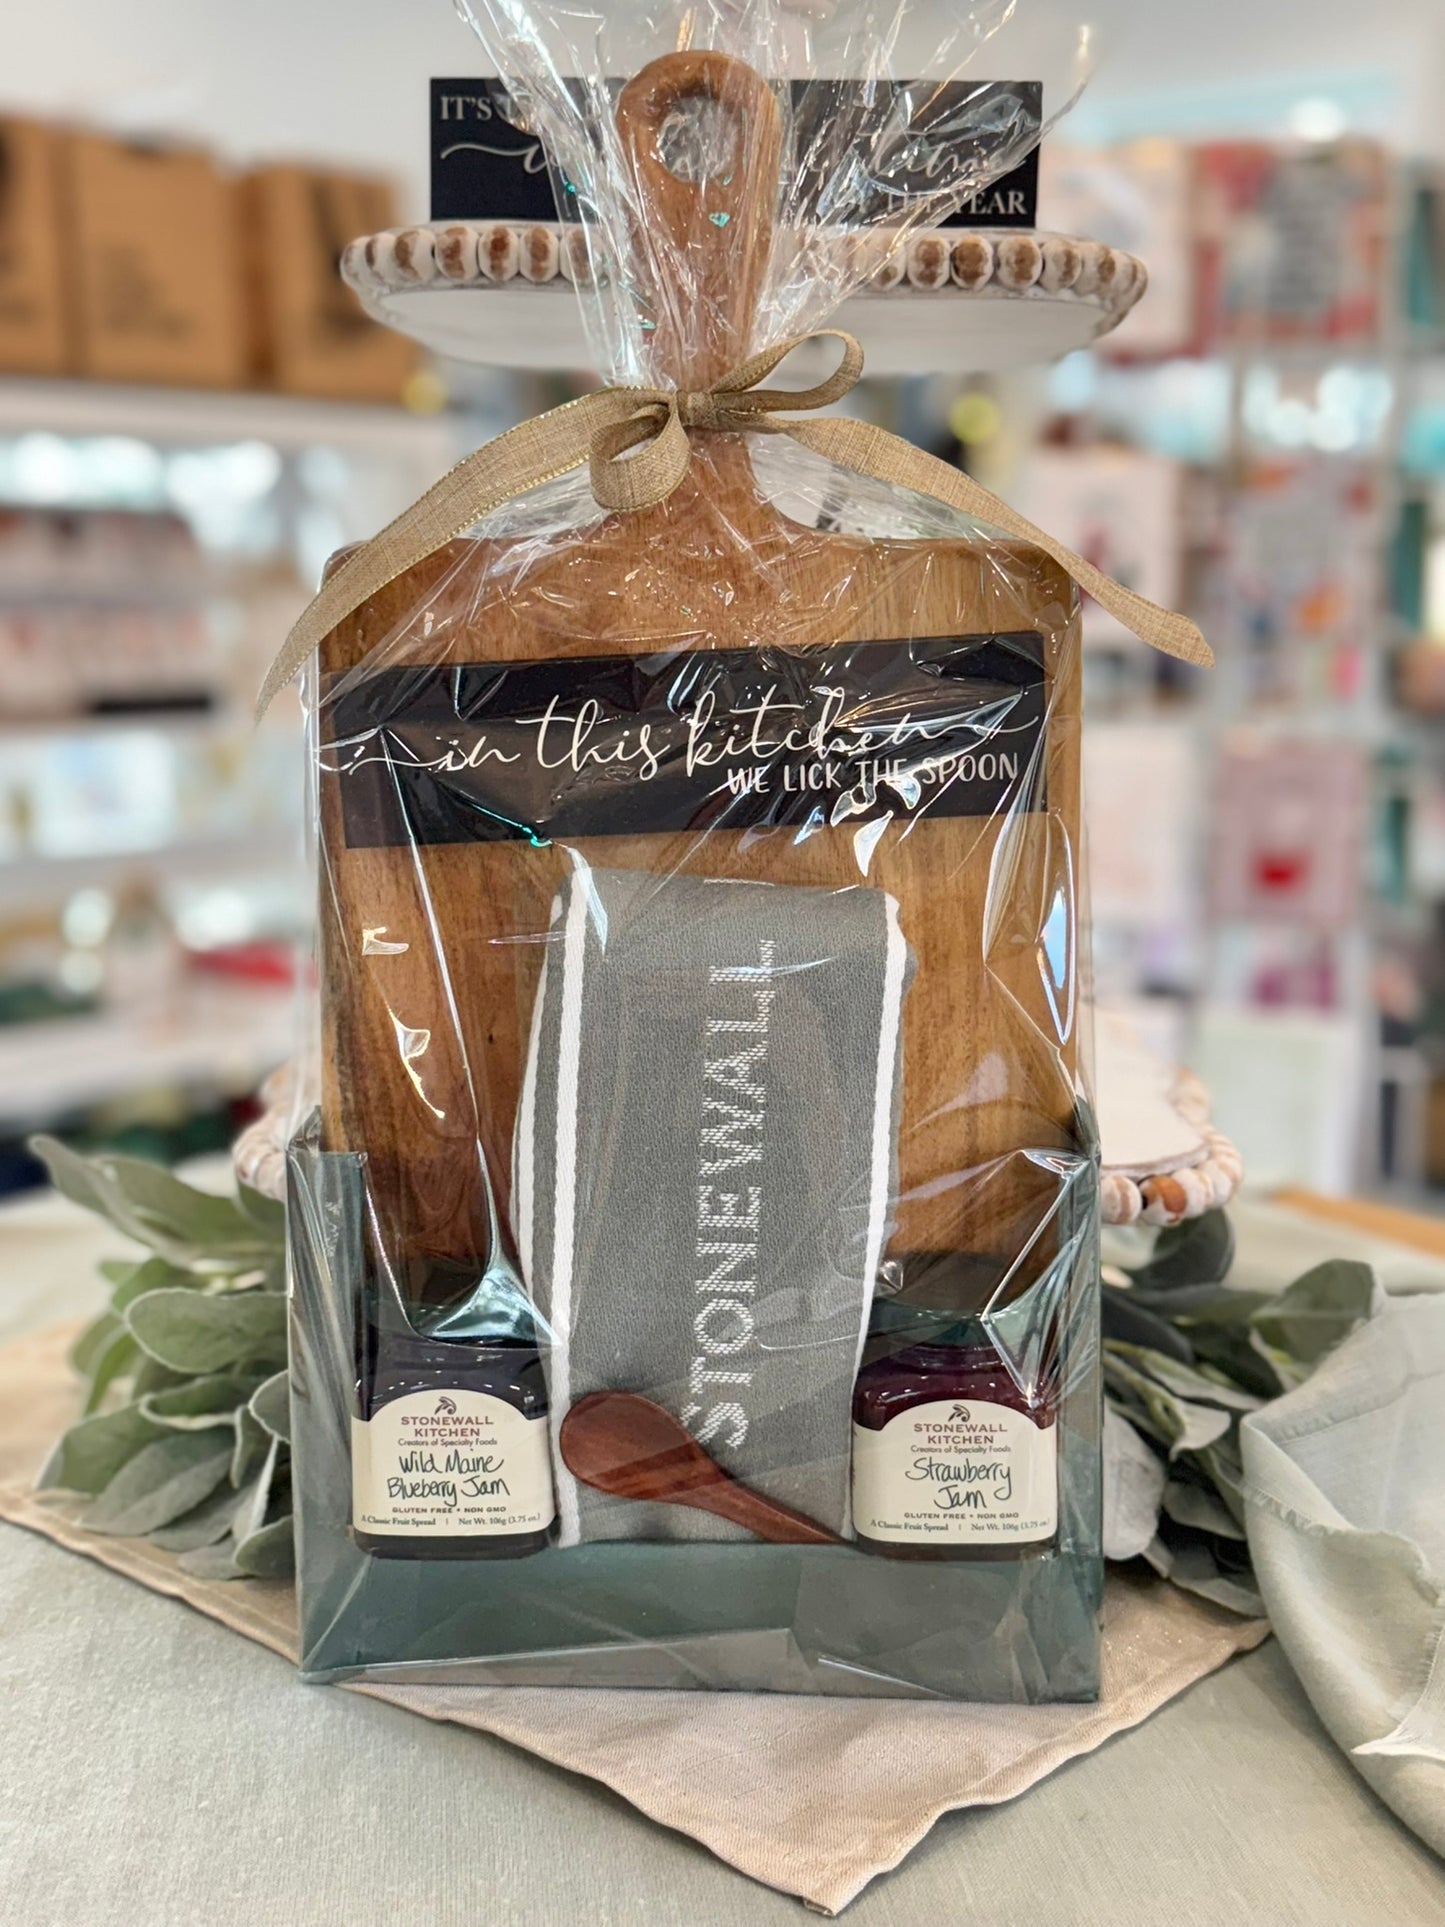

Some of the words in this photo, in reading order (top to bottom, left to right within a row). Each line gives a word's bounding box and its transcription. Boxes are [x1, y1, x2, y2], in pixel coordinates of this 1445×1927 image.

[440, 96, 492, 120] IT'S
[951, 191, 1028, 216] YEAR
[515, 694, 672, 781] this
[686, 683, 1039, 778] kitchen
[727, 766, 770, 795] WE
[783, 761, 842, 791] LICK
[855, 758, 908, 786] THE
[922, 751, 1019, 785] SPOON
[679, 938, 778, 1450] STONEWALL
[401, 1416, 494, 1425] STONEWALL
[914, 1423, 1008, 1433] STONEWALL
[414, 1428, 480, 1437] KITCHEN
[431, 1438, 439, 1446] of
[440, 1438, 474, 1448] Specialty
[475, 1438, 498, 1446] Foods
[927, 1435, 994, 1444] KITCHEN
[399, 1450, 443, 1474] Wild
[445, 1448, 504, 1475] Maine
[911, 1445, 942, 1453] Creators
[944, 1445, 952, 1453] of
[954, 1445, 987, 1455] Specialty
[989, 1445, 1011, 1453] Foods
[461, 1475, 510, 1498] Jam
[905, 1456, 1012, 1500] Strawberry
[934, 1484, 987, 1509] Jam
[367, 1515, 390, 1524] Classic
[392, 1517, 410, 1525] Fruit
[411, 1518, 436, 1527] Spread
[878, 1520, 902, 1529] Classic
[904, 1522, 922, 1530] Fruit
[924, 1523, 949, 1532] Spread
[971, 1523, 984, 1531] Net
